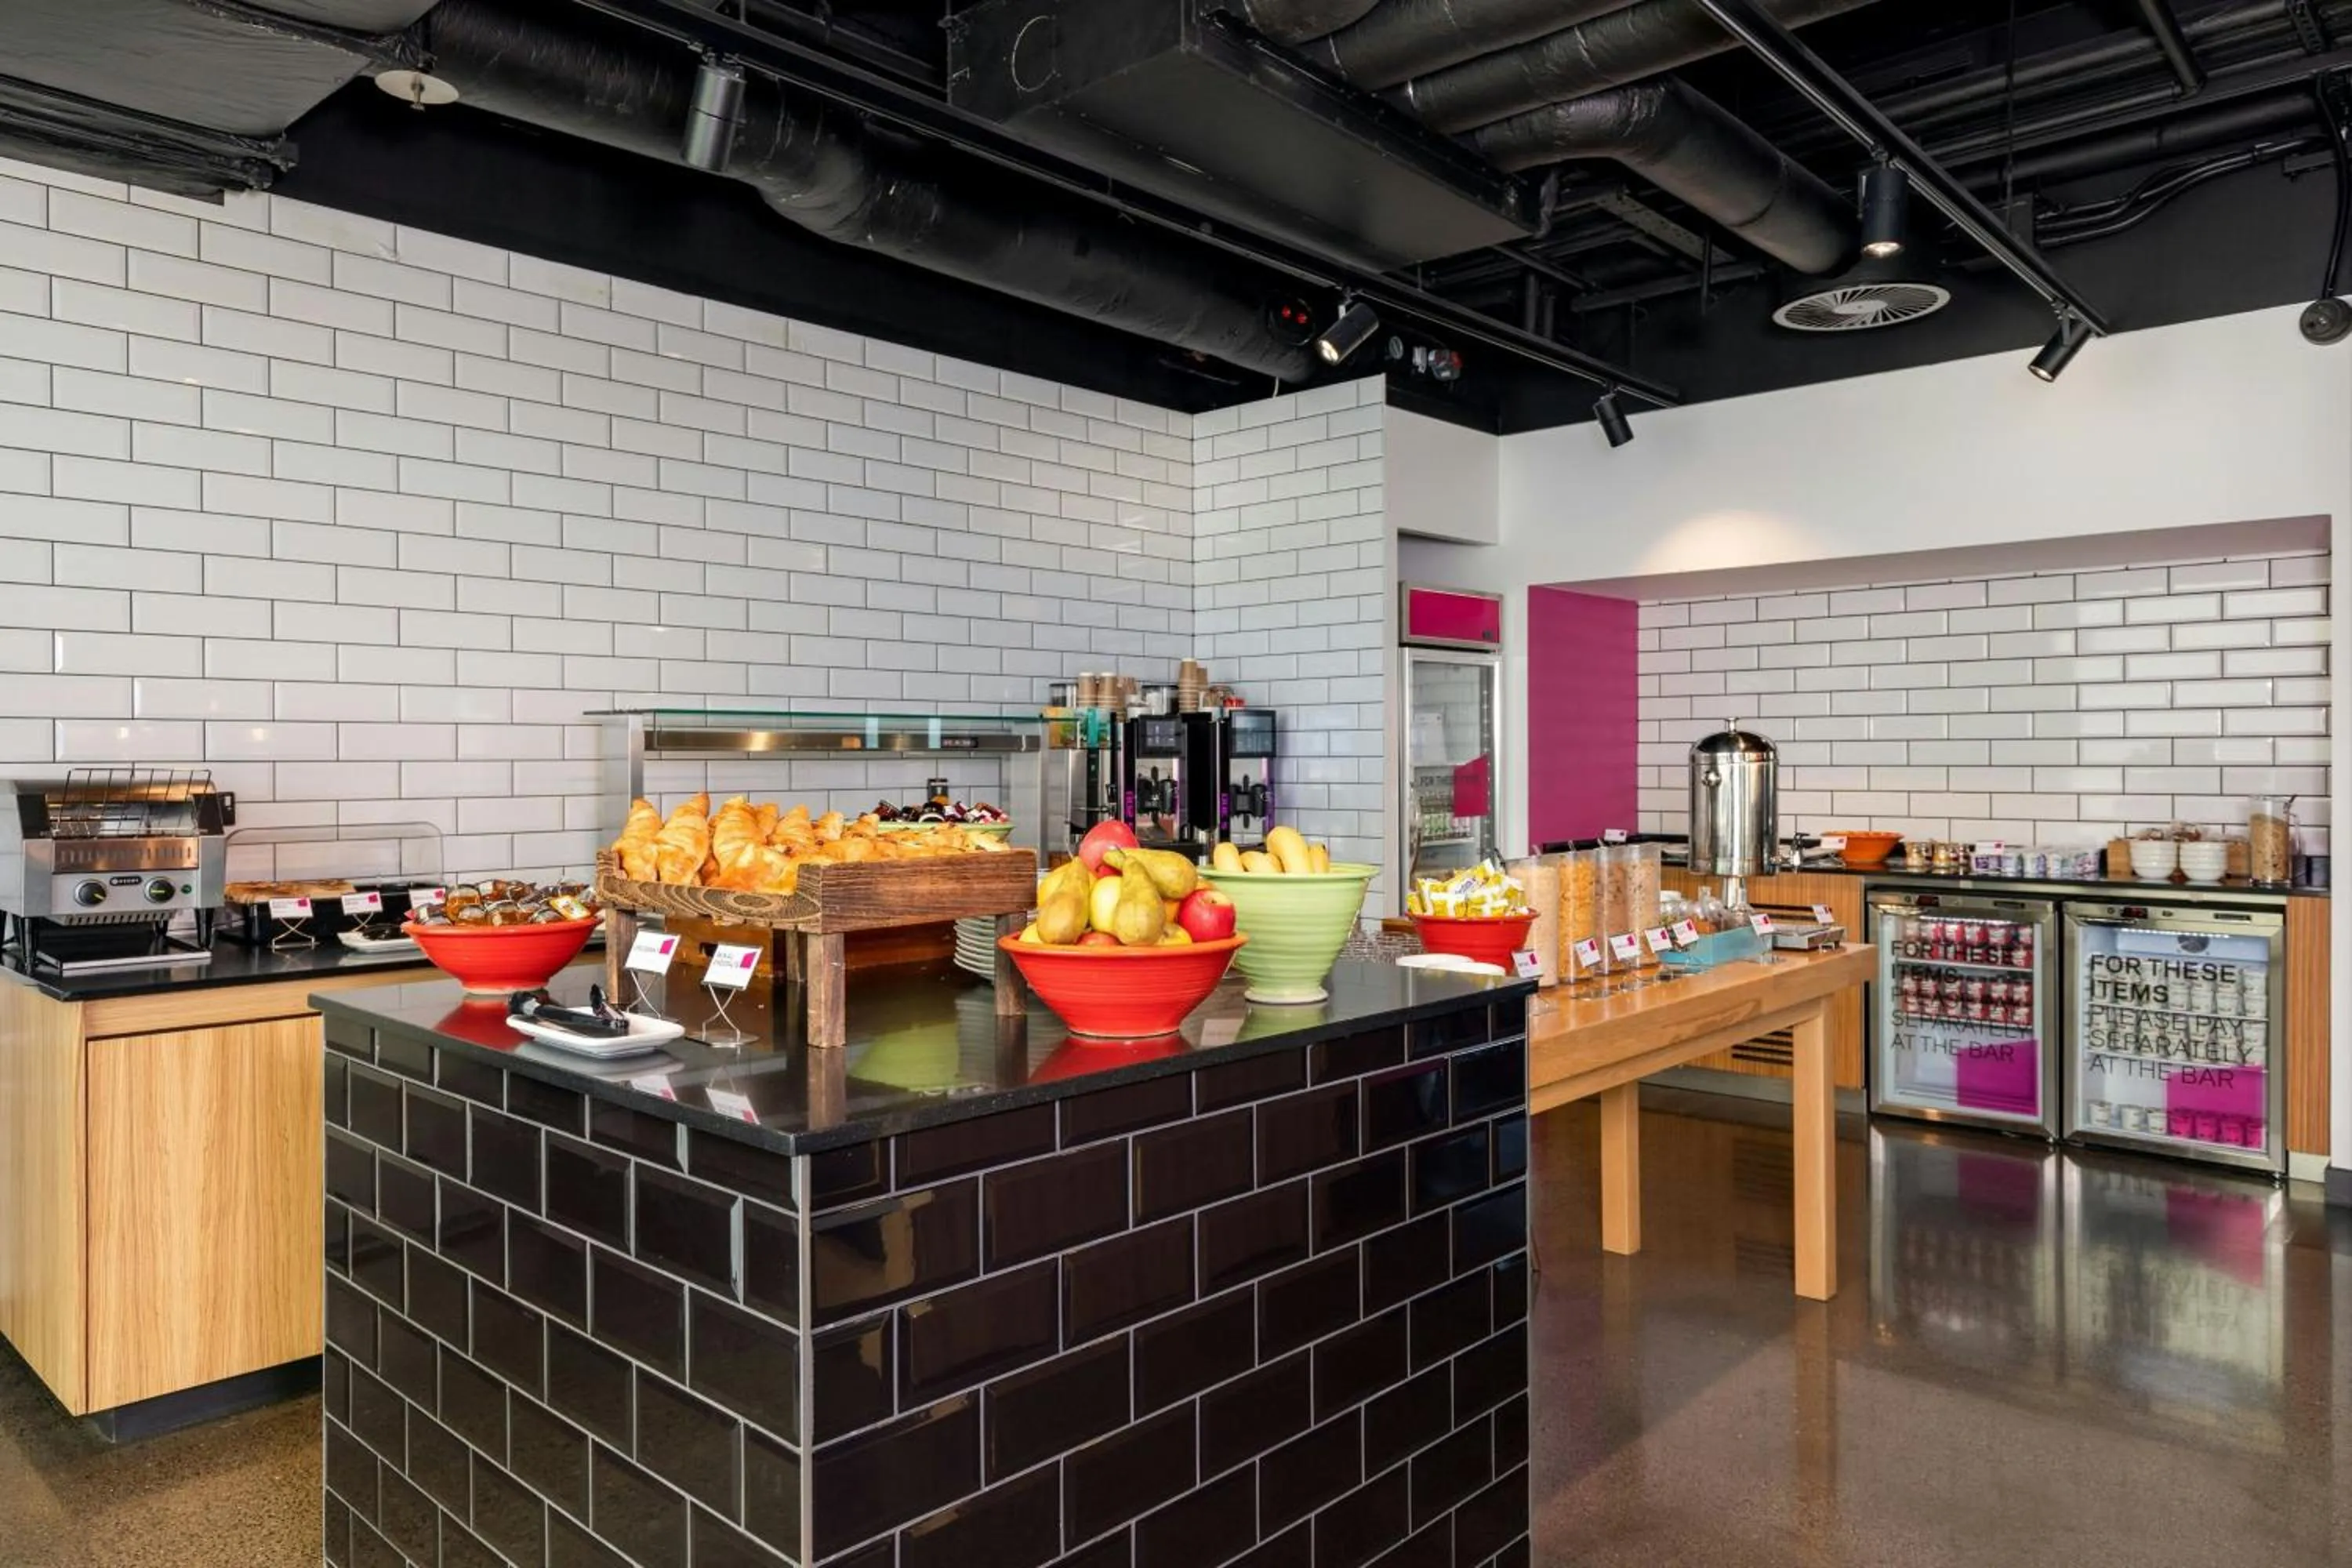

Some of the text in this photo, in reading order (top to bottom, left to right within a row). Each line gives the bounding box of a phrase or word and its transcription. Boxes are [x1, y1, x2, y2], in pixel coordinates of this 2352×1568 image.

[1891, 940, 2013, 967] FOR THESE
[2090, 953, 2236, 983] FOR THESE
[1892, 963, 1959, 984] ITEMS
[2089, 979, 2169, 1004] ITEMS
[2089, 1004, 2245, 1037] PLEASE PAY
[1891, 1033, 2015, 1062] AT THE BAR
[2089, 1029, 2254, 1067] SEPARATELY
[2089, 1054, 2234, 1089] AT THE BAR
